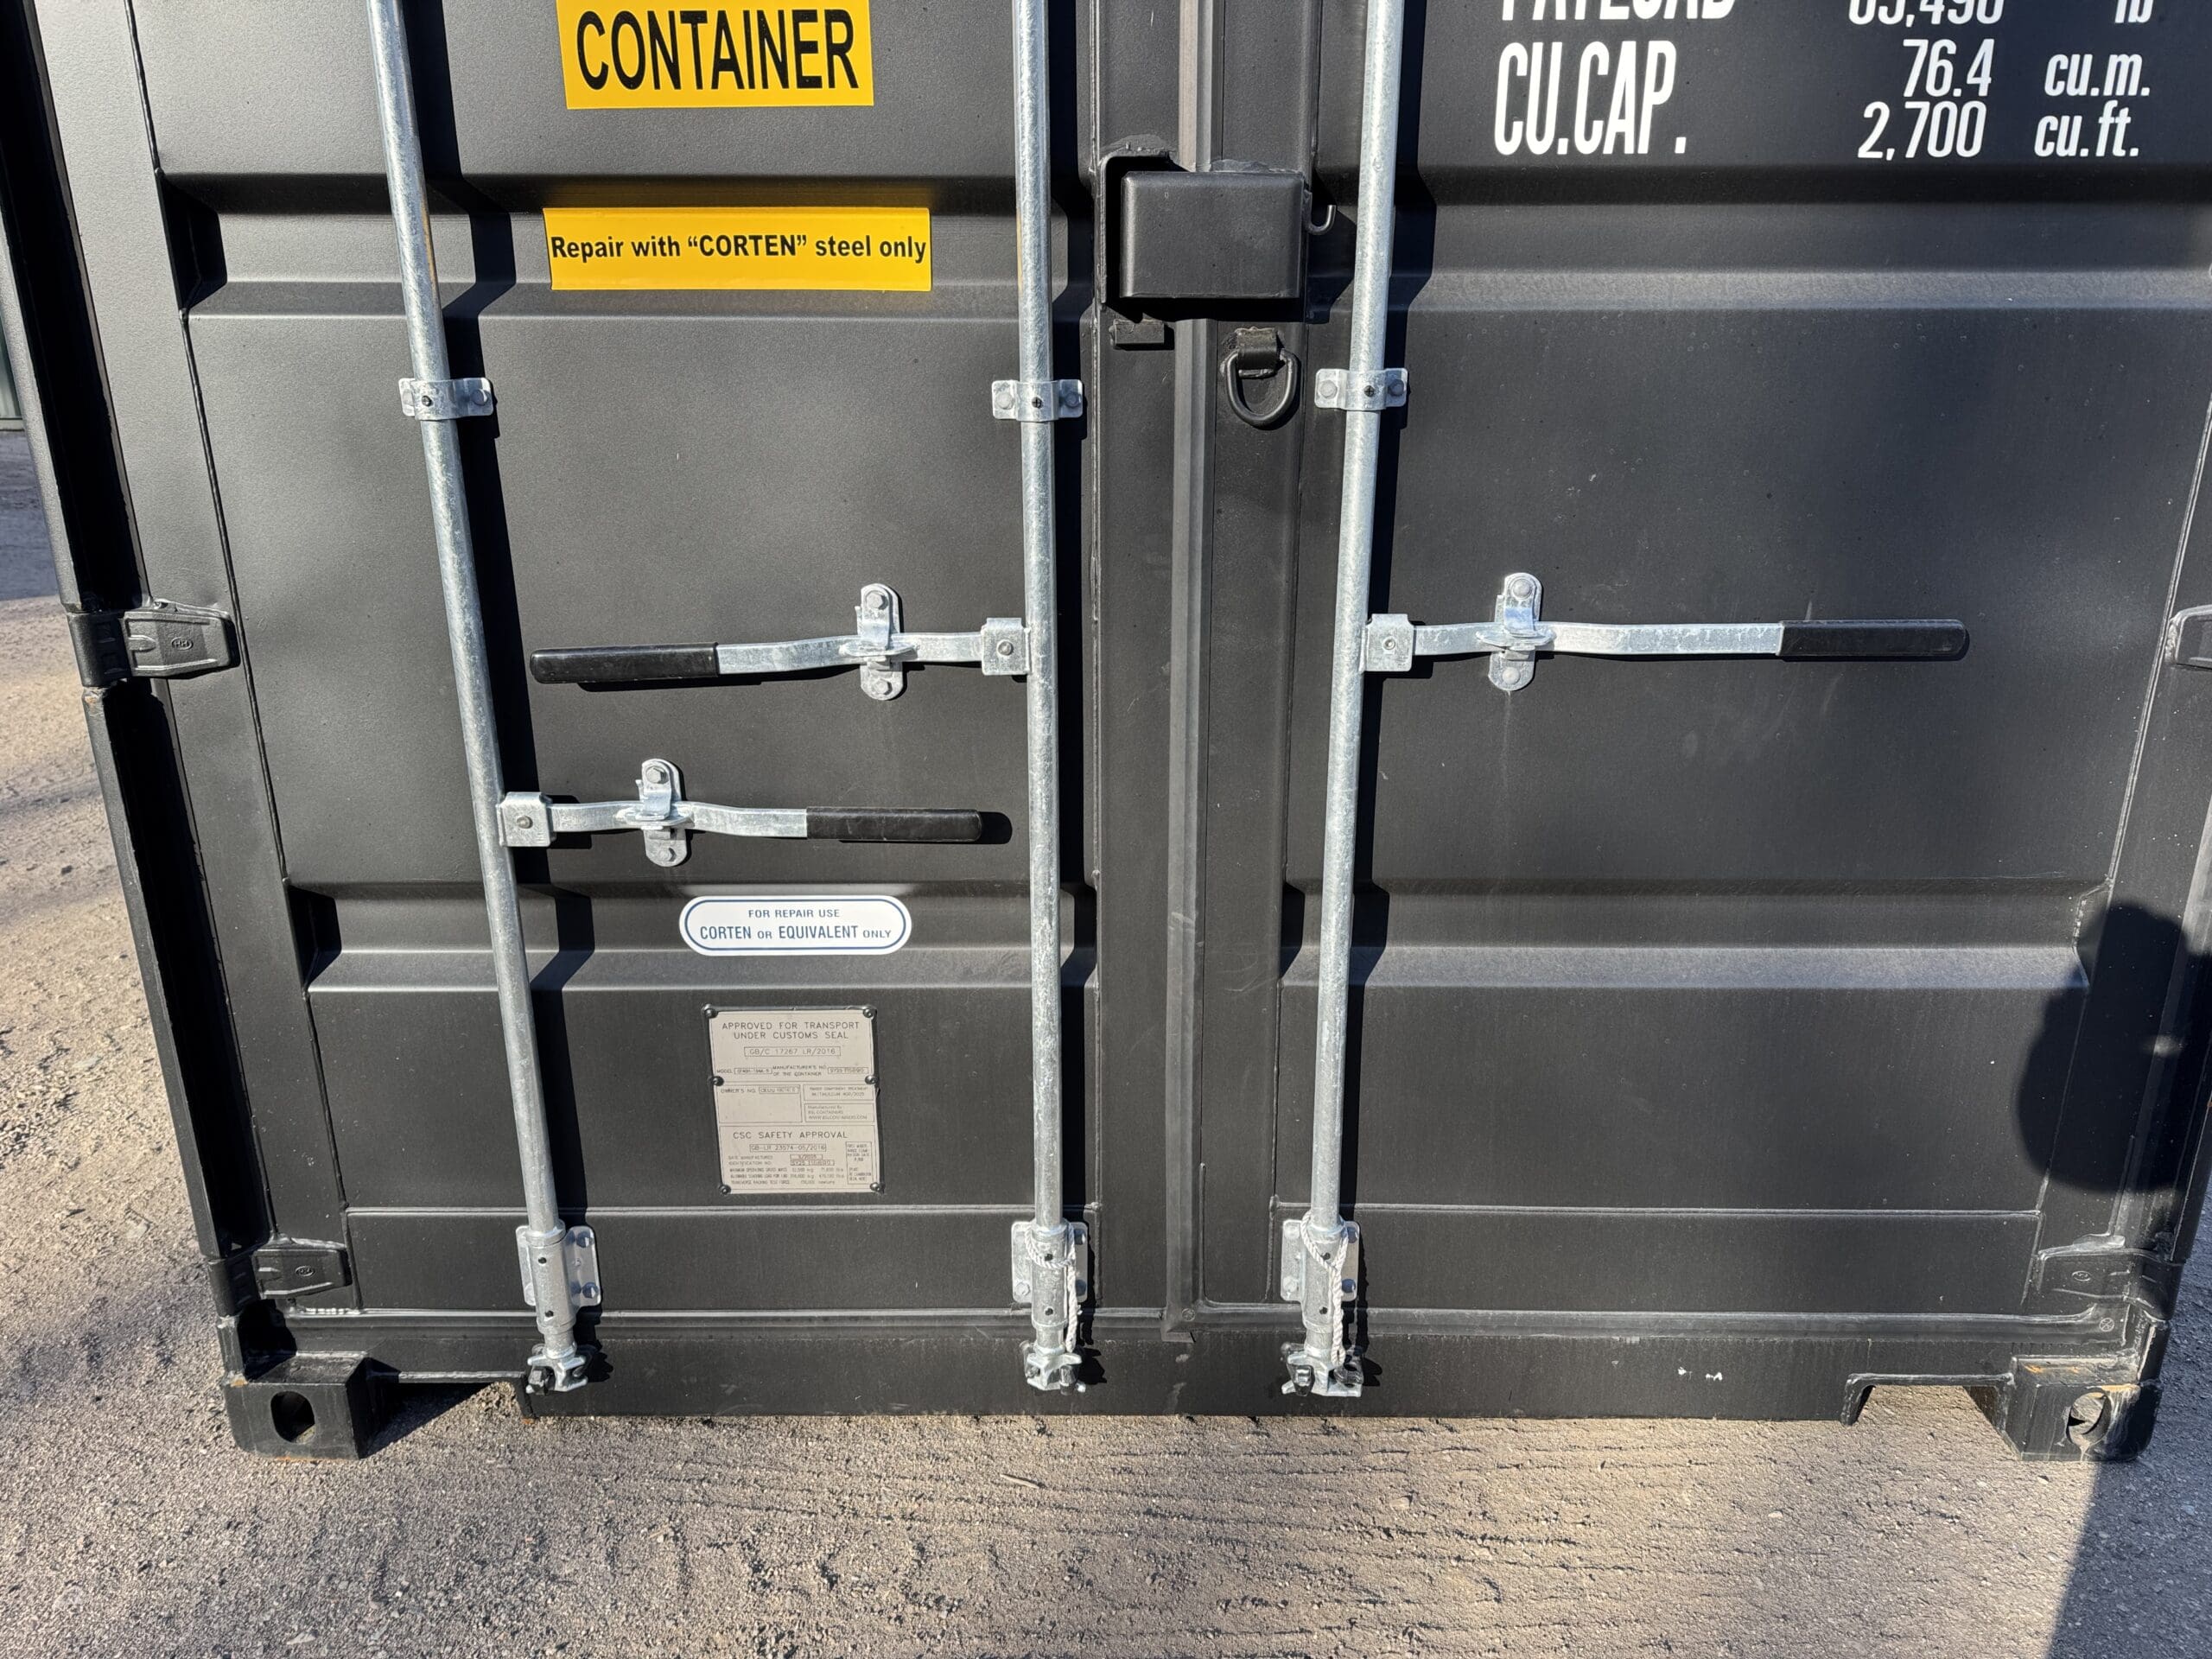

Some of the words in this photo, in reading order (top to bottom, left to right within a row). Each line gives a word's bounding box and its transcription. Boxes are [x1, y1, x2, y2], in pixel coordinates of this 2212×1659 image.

[577, 10, 859, 90] CONTAINER
[1903, 38, 1994, 97] 76.4
[2044, 54, 2150, 97] cu.m.
[1858, 100, 1986, 161] 2,700
[2034, 99, 2139, 157] cu.ft.
[551, 237, 623, 263] Repair
[631, 235, 680, 257] with
[816, 236, 871, 257] steel
[880, 236, 926, 264] only
[700, 926, 752, 939] CORTEN
[757, 931, 772, 939] OR
[779, 925, 859, 939] EQUIVALENT
[863, 930, 892, 938] ONLY
[748, 910, 770, 918] FOR
[775, 909, 814, 918] REPAIR
[818, 909, 841, 918] USE
